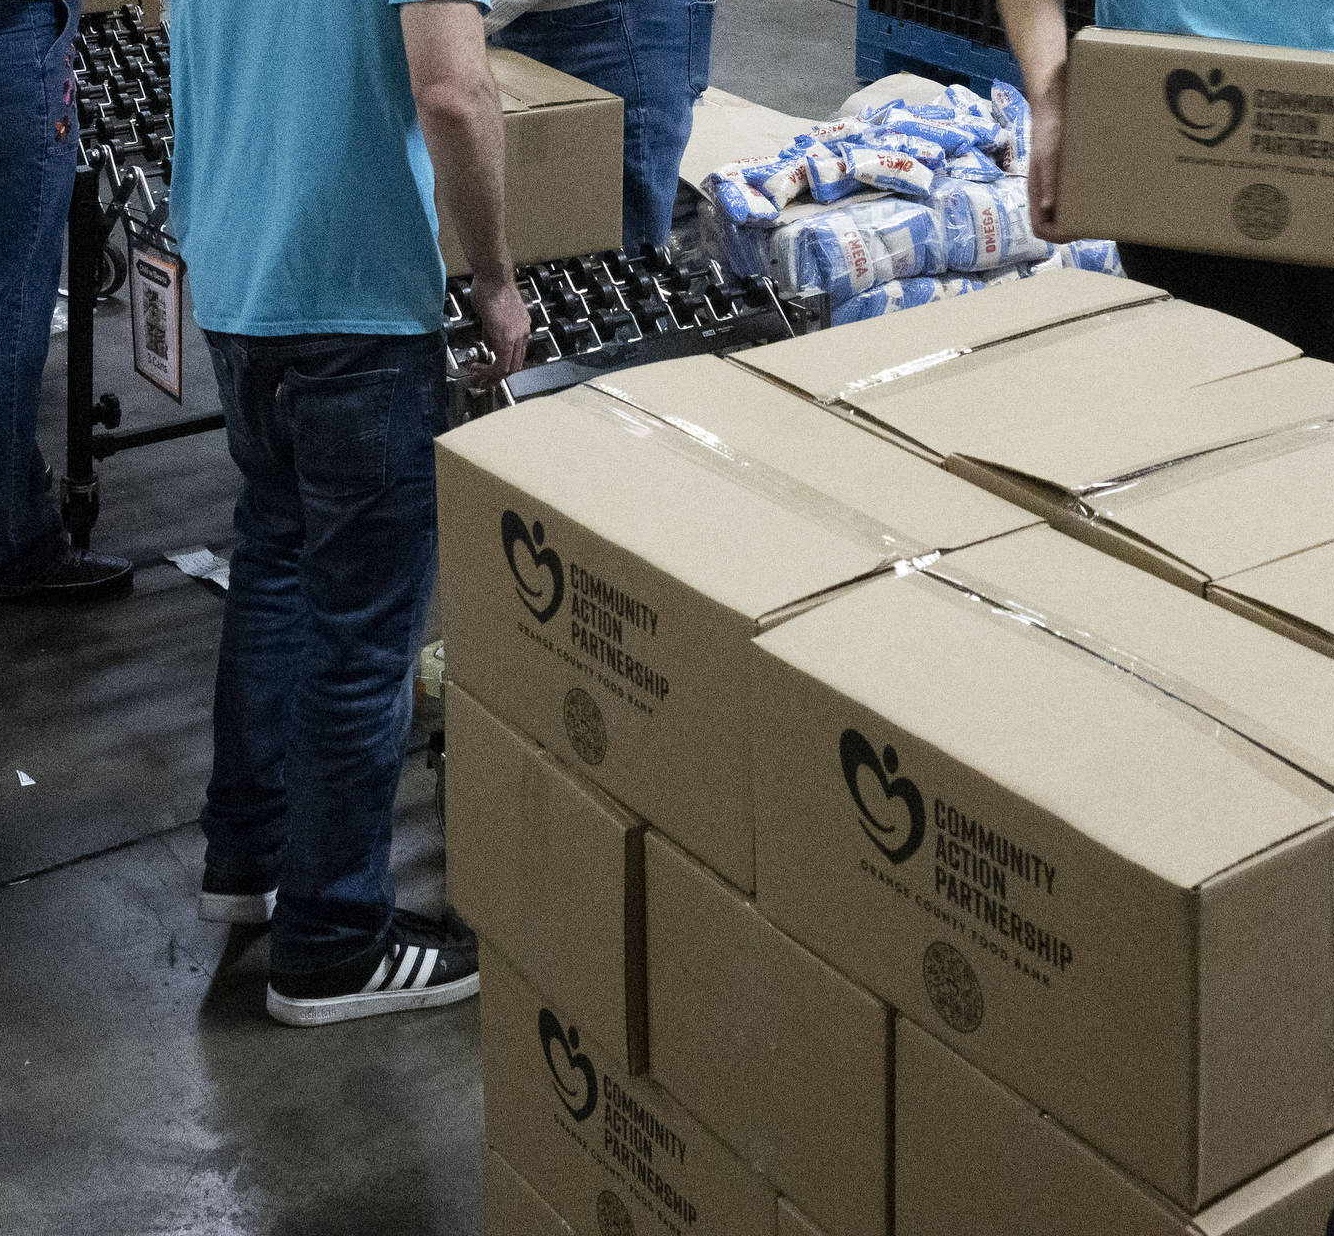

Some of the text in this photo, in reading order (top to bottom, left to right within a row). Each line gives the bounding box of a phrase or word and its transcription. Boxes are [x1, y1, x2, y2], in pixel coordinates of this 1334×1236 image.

[843, 231, 869, 279] OMEGA
[983, 207, 997, 254] OMEGA
[570, 563, 658, 636] COMMUNITY
[571, 593, 623, 645] ACTION
[571, 621, 670, 701] PARTNERSHIP
[934, 798, 1055, 895] COMMUNITY
[935, 833, 1007, 900] ACTION
[859, 858, 1051, 988] ORANGE COUNTY FOOD BANK
[935, 866, 1073, 972] PARTNERSHIP
[604, 1074, 687, 1165] COMMUNITY
[605, 1103, 653, 1163] ACTION
[604, 1128, 698, 1227] PARTNERSHIP
